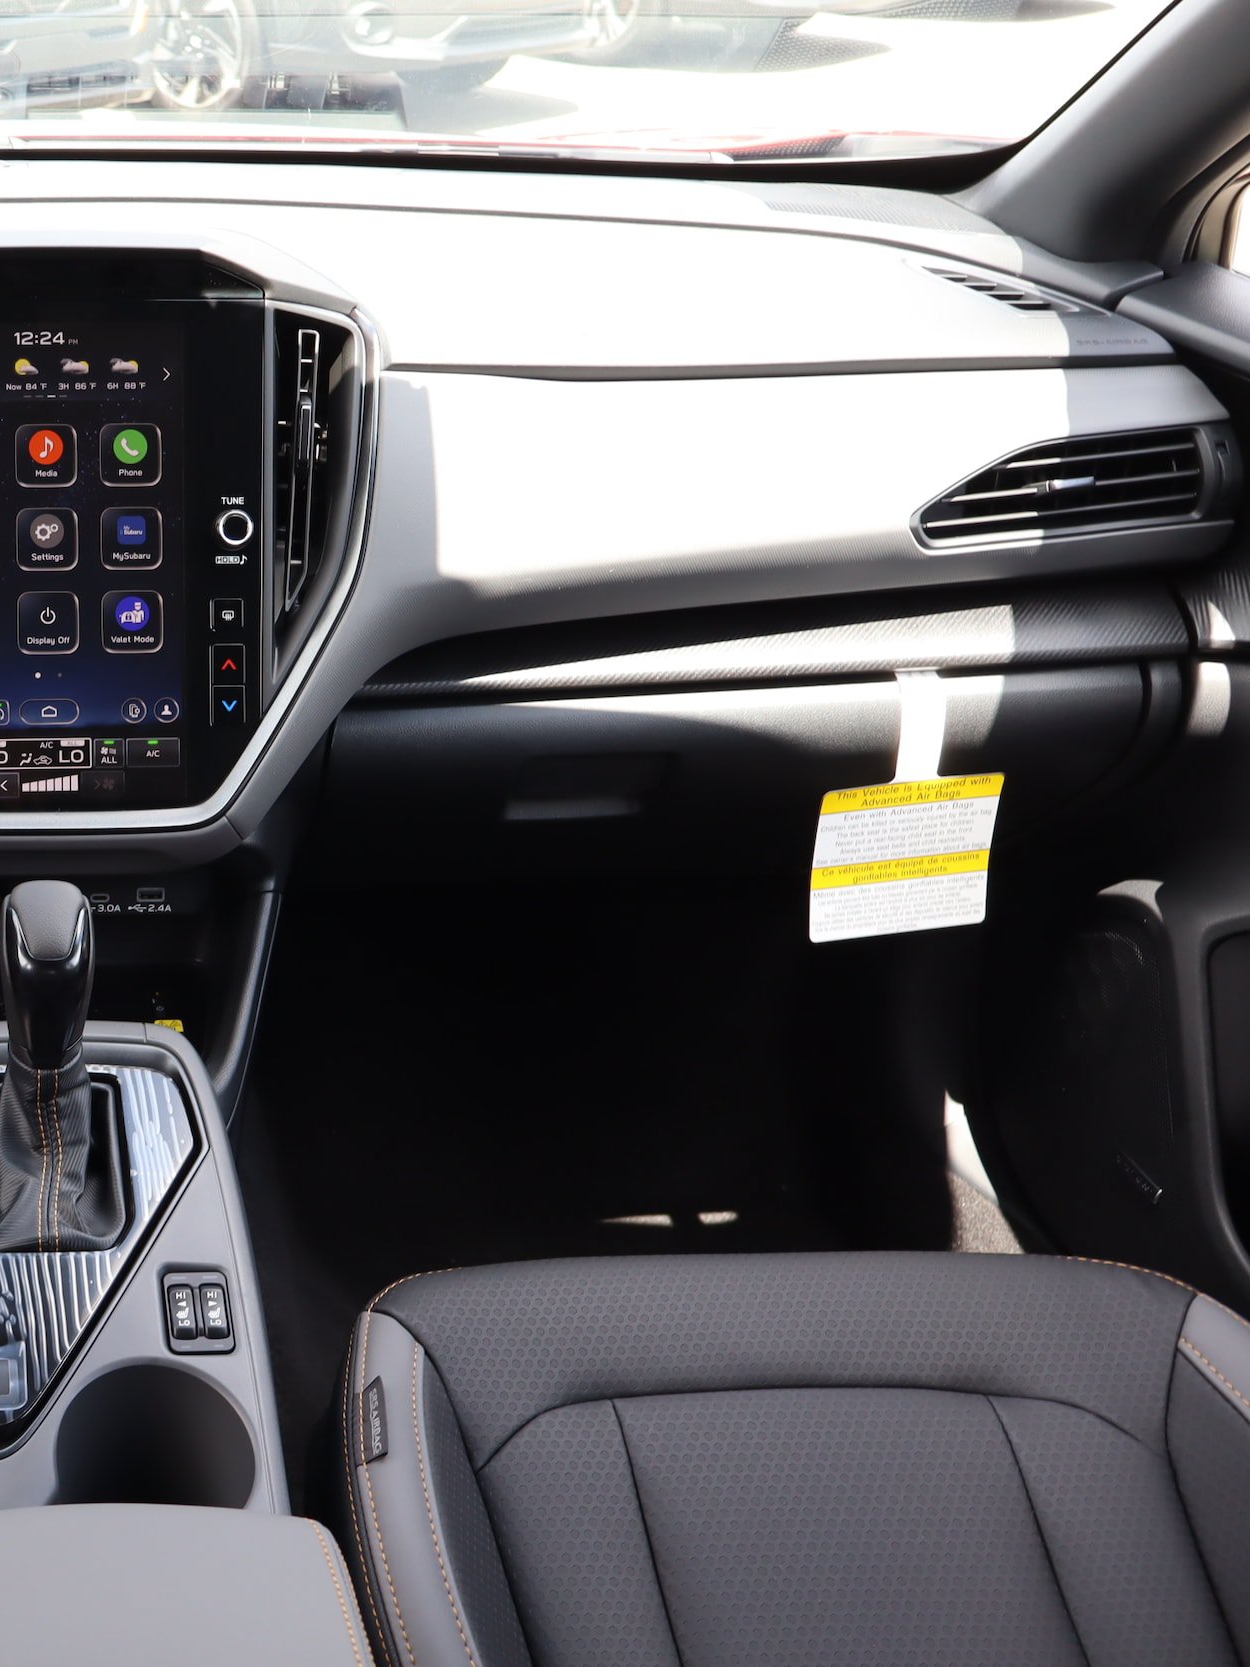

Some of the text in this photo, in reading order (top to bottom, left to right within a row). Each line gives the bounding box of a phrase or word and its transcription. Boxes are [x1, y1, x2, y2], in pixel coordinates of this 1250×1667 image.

[14, 332, 65, 346] 12:24
[106, 382, 119, 390] 6H
[35, 470, 58, 478] Media
[118, 468, 143, 477] Phone
[221, 497, 245, 506] TUNE
[31, 553, 64, 562] Settings
[112, 552, 151, 562] MySubaru
[215, 556, 240, 564] HOLD
[26, 636, 70, 646] Display Off
[110, 634, 154, 644] Valet Mode
[58, 750, 84, 763] LO
[146, 750, 160, 758] A/C
[837, 790, 857, 800] This
[862, 785, 898, 796] Vehicle
[917, 778, 966, 792] Equipped
[970, 775, 990, 785] with
[860, 788, 960, 806] Advanced Air Bags
[843, 812, 865, 821] Even
[869, 810, 885, 818] with
[890, 805, 932, 815] Advanced
[952, 800, 974, 810] Bags
[821, 868, 834, 876] Ce
[838, 864, 873, 874] véhicule
[878, 862, 890, 870] est
[927, 856, 937, 864] de
[941, 852, 979, 862] coussins
[852, 864, 947, 884] gonflables intelligents
[97, 904, 121, 912] 3.0A
[148, 904, 172, 912] 2.4A
[176, 1292, 186, 1300] HI
[371, 1411, 383, 1454] AIRBAG
